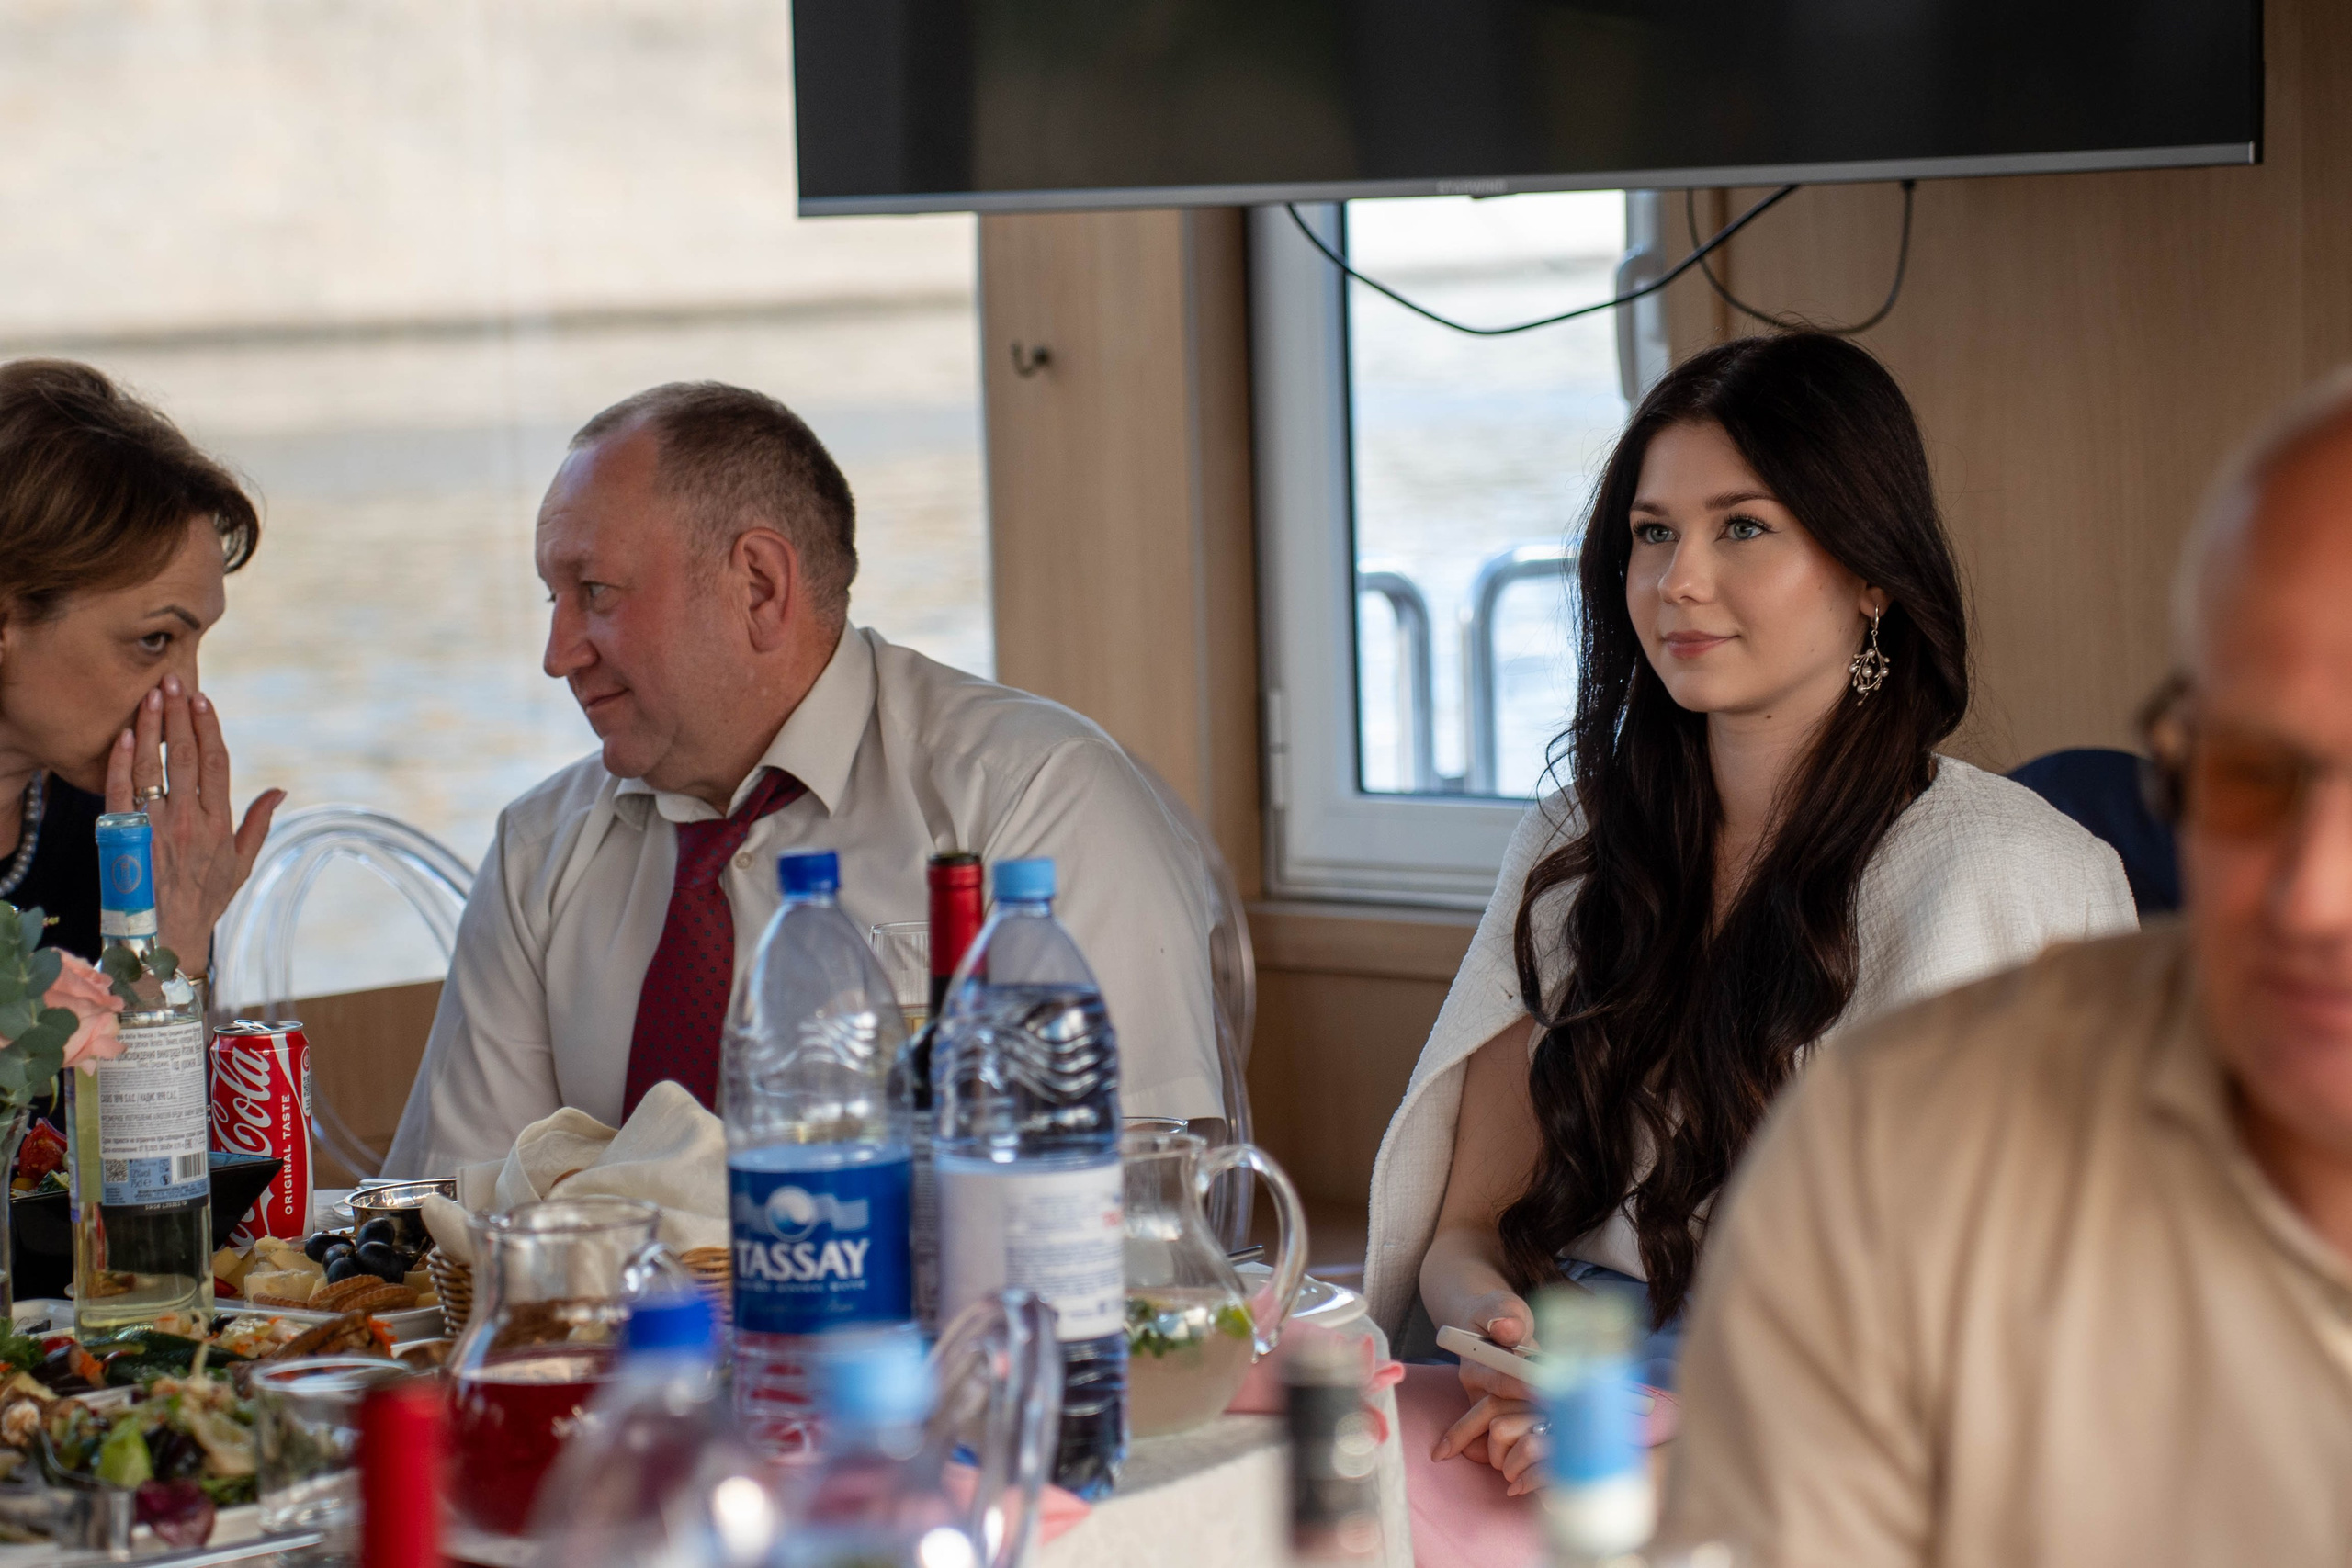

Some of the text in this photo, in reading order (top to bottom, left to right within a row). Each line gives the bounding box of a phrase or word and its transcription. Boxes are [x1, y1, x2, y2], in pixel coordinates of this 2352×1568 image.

[281, 1093, 294, 1215] ORIGINAL TASTE
[735, 1238, 871, 1282] TASSAY
